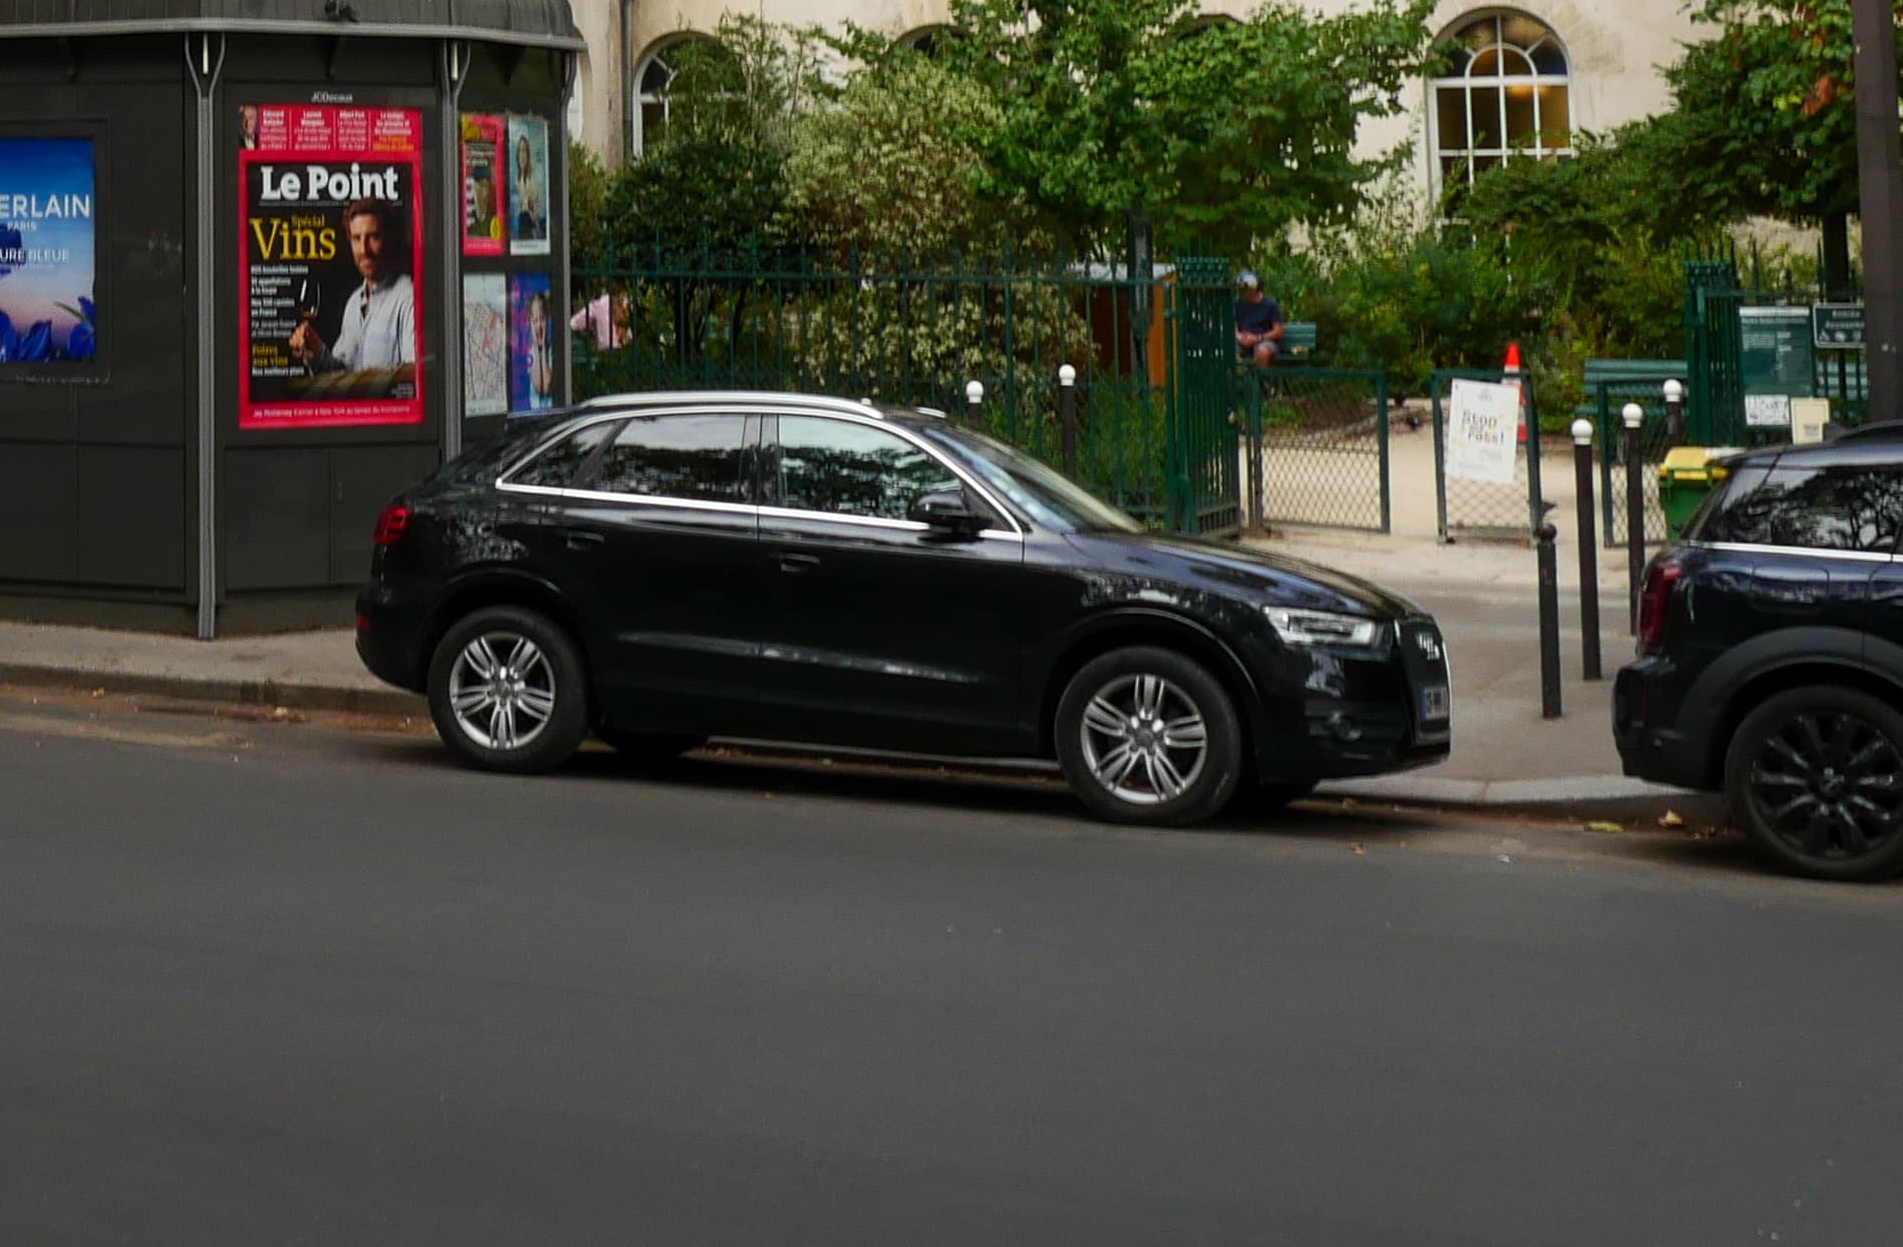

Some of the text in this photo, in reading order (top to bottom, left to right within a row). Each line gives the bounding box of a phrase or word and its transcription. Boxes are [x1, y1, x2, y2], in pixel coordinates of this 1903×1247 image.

[261, 162, 399, 201] Le Point
[6, 221, 38, 232] PARIS
[250, 217, 337, 261] Vins
[28, 248, 70, 263] BLEUE
